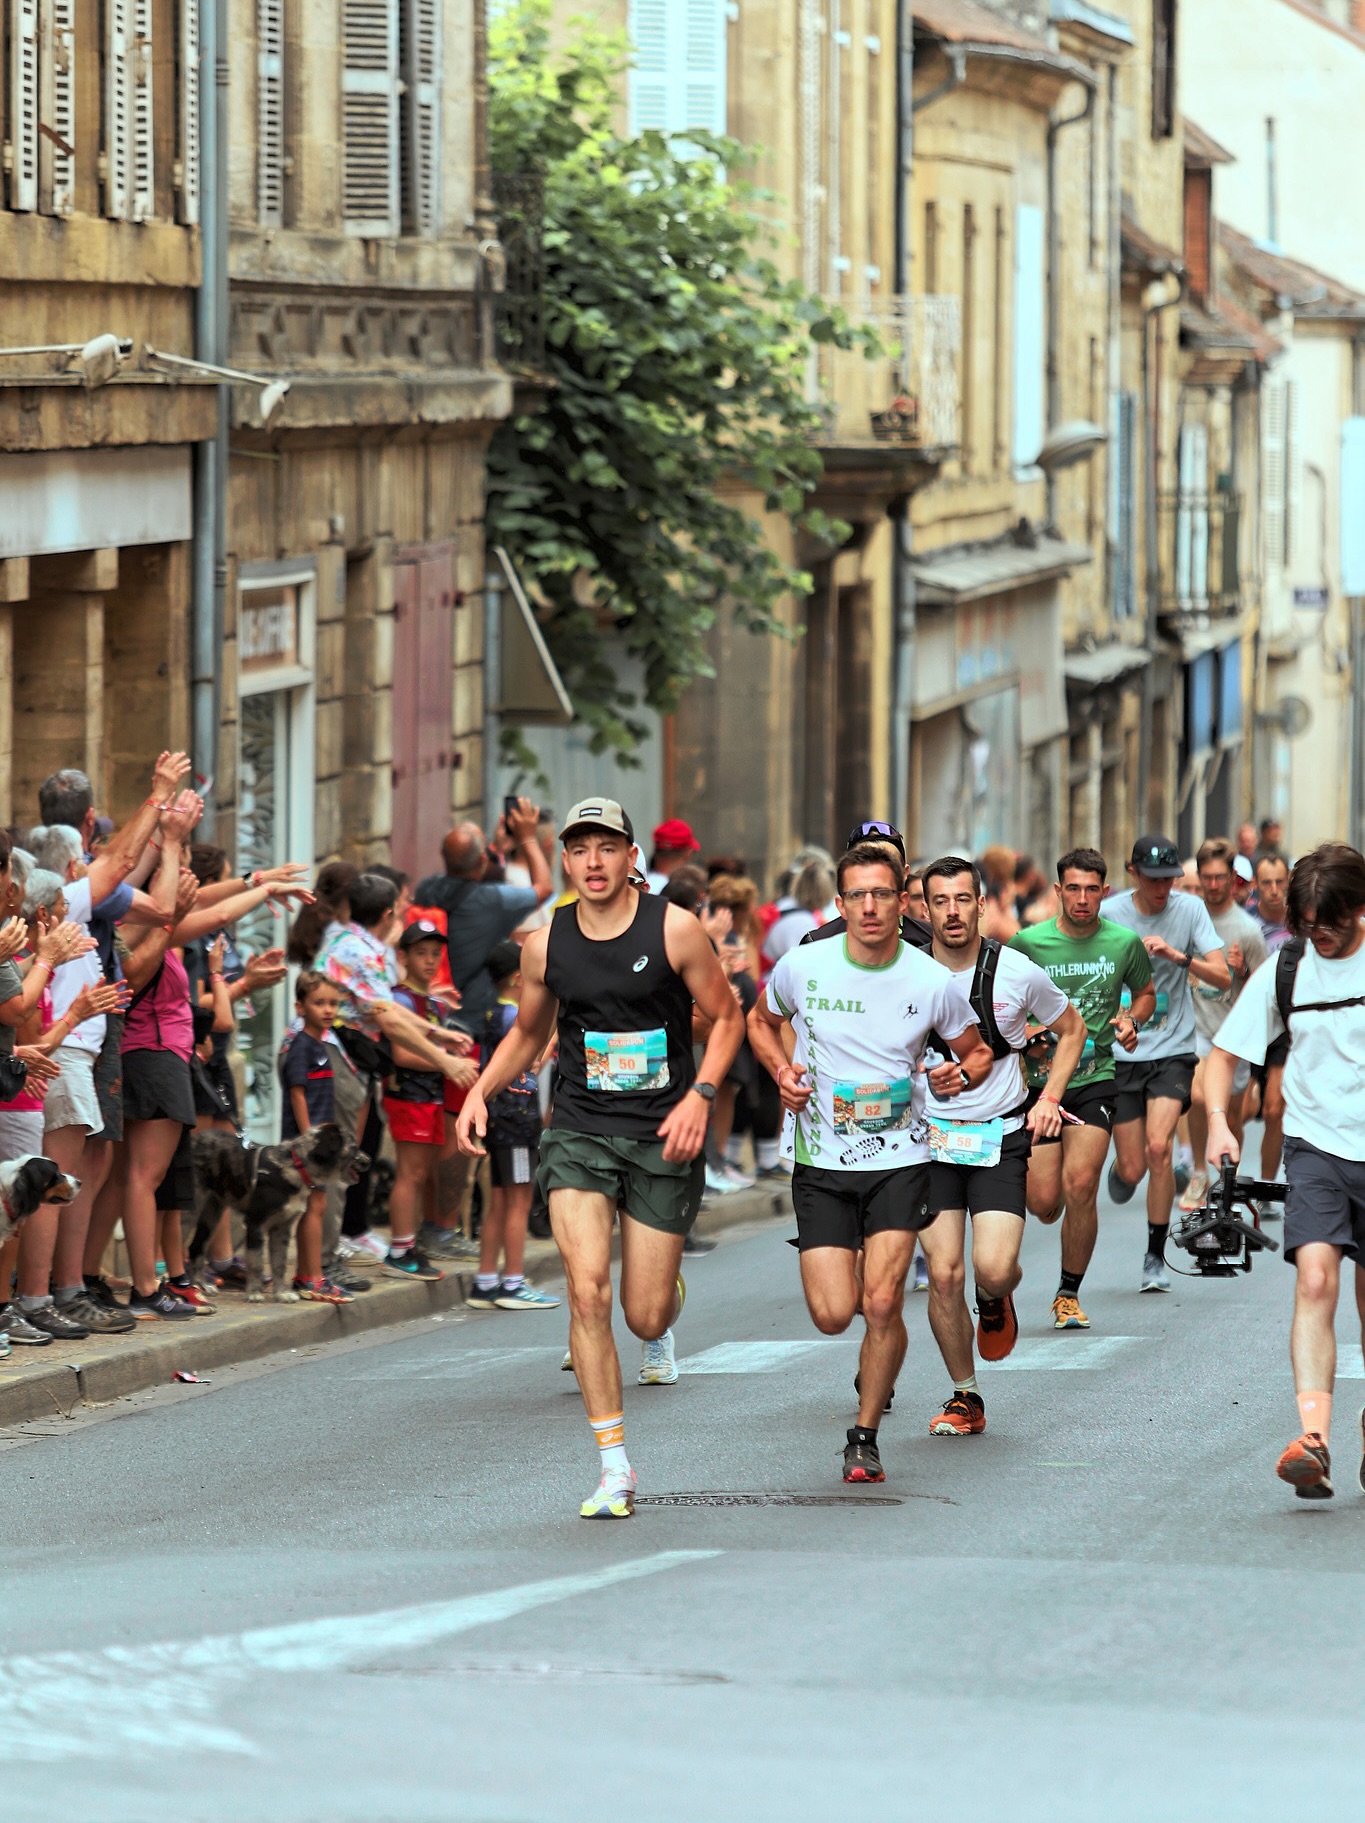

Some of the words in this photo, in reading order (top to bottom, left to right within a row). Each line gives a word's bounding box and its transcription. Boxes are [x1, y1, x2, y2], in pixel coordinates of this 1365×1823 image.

[806, 997, 866, 1013] TRAIL
[618, 1057, 636, 1071] 50
[865, 1104, 881, 1116] 82
[957, 1136, 972, 1147] 58
